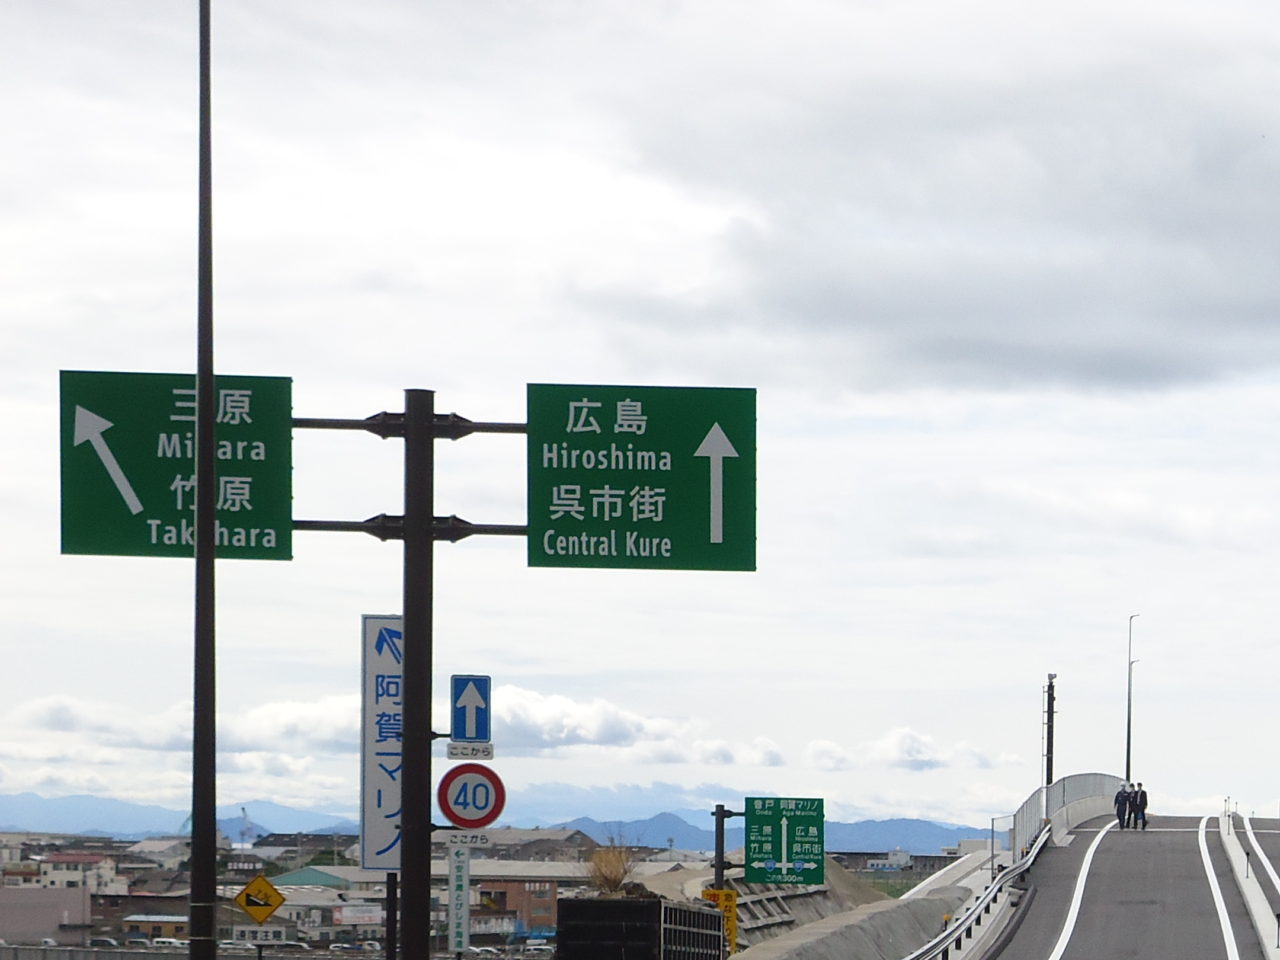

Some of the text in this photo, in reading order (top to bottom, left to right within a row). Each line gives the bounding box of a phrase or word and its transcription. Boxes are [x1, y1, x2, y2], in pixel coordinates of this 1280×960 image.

[566, 398, 648, 435] 広島
[157, 433, 266, 461] Miara
[542, 442, 672, 471] Hiroshima
[549, 484, 666, 522] 呉市街
[147, 518, 276, 548] Takhara
[543, 529, 672, 557] Central Kure
[450, 746, 491, 757] ここから
[453, 782, 490, 811] 40
[450, 834, 489, 845] ここから
